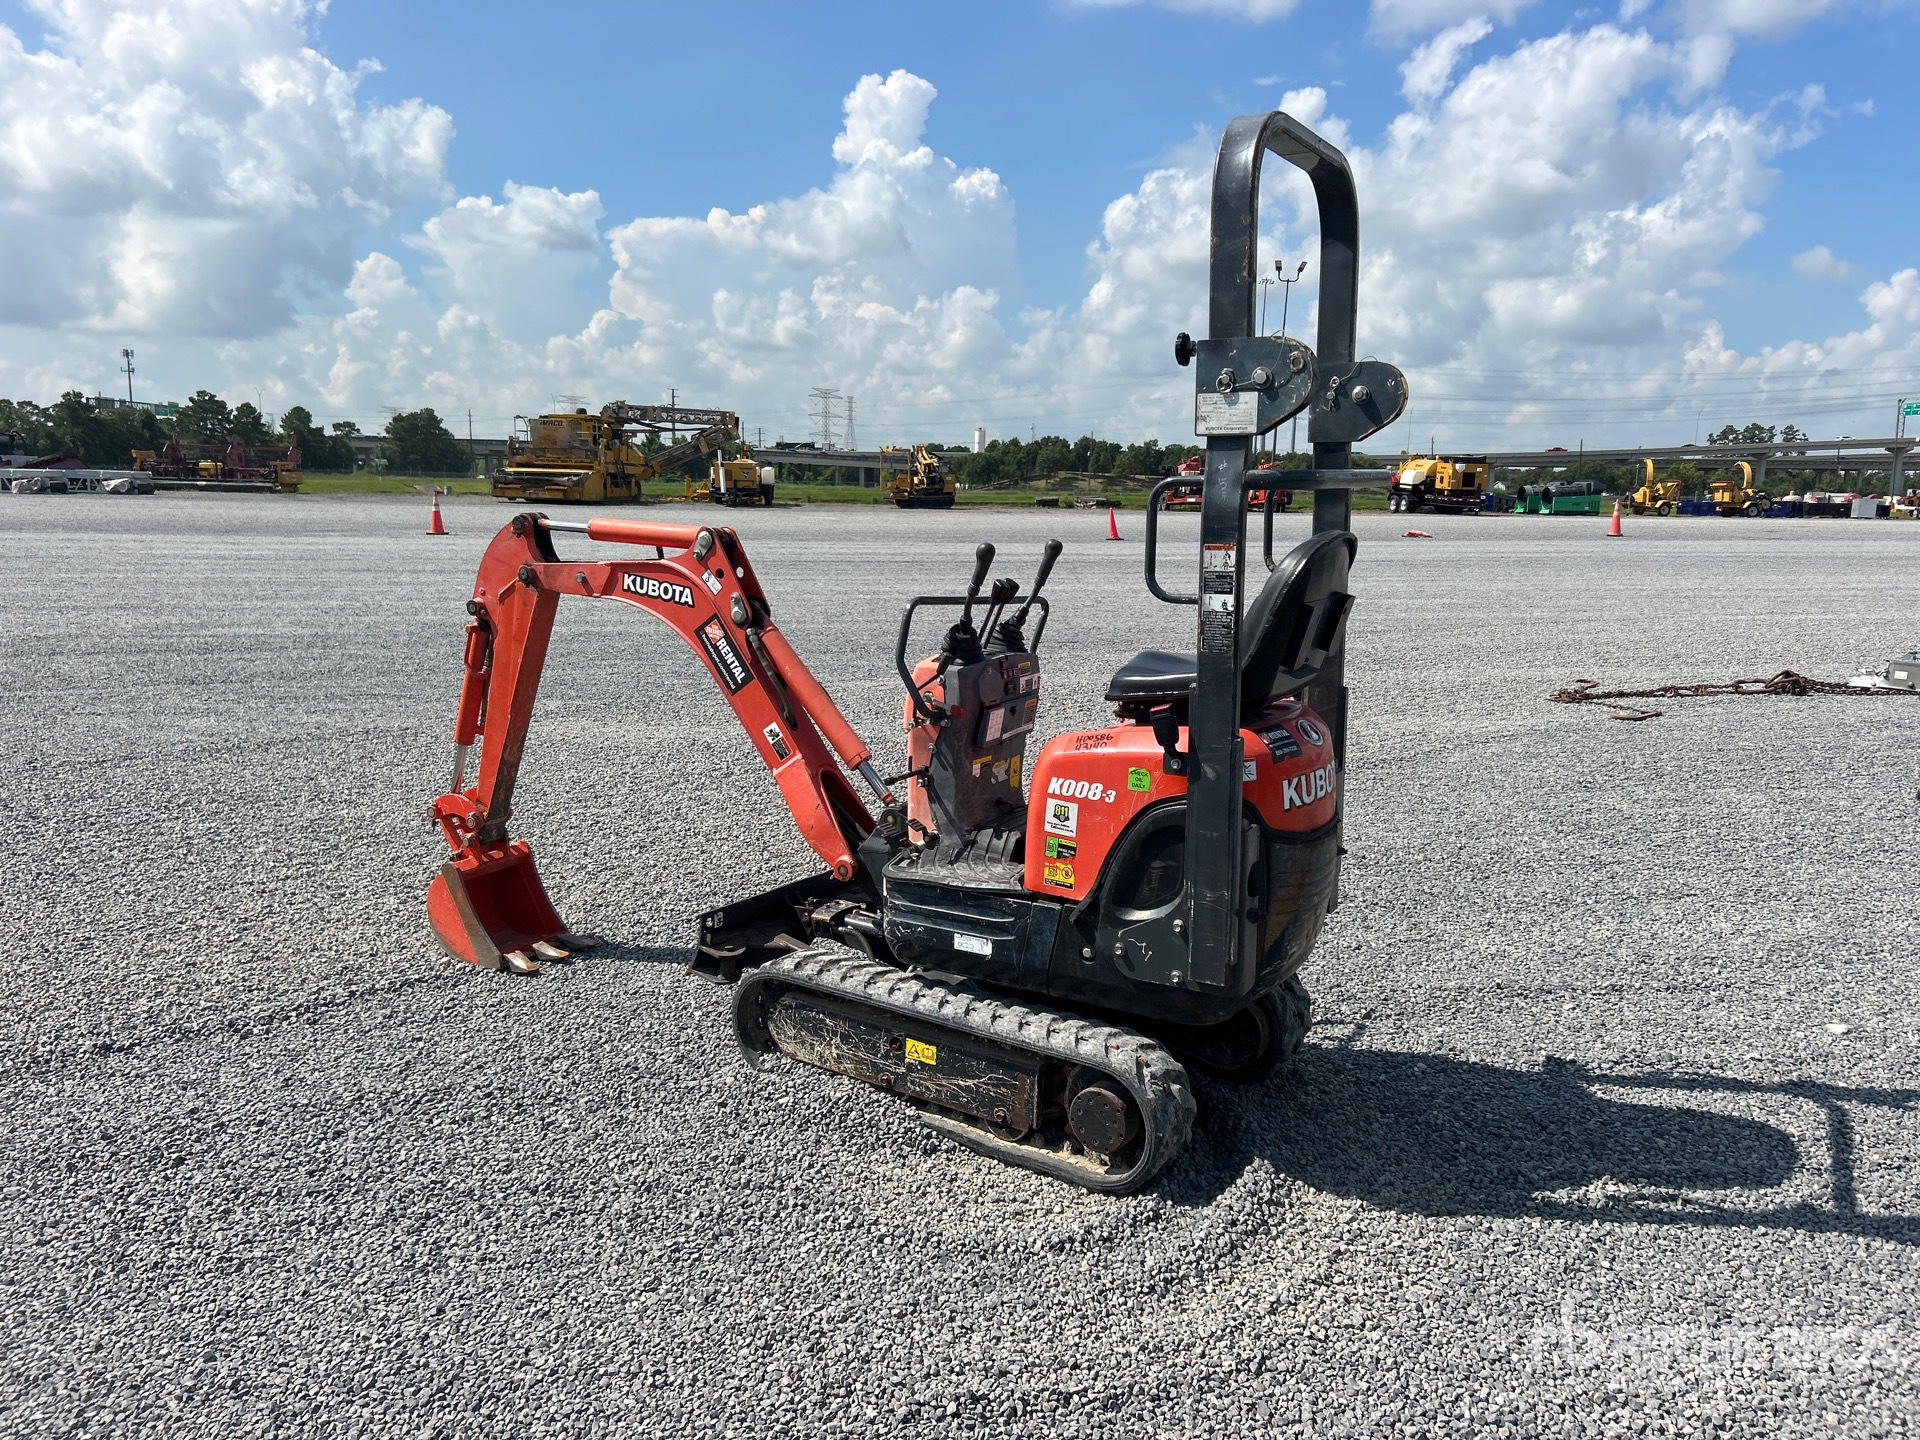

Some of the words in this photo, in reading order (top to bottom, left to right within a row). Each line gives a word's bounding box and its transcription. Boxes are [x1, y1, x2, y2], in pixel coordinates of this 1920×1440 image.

[623, 573, 694, 606] KUBOTA
[716, 637, 747, 684] RENTAL
[1047, 776, 1117, 804] K008-3
[1131, 782, 1146, 790] DAILY
[1055, 804, 1069, 817] 811
